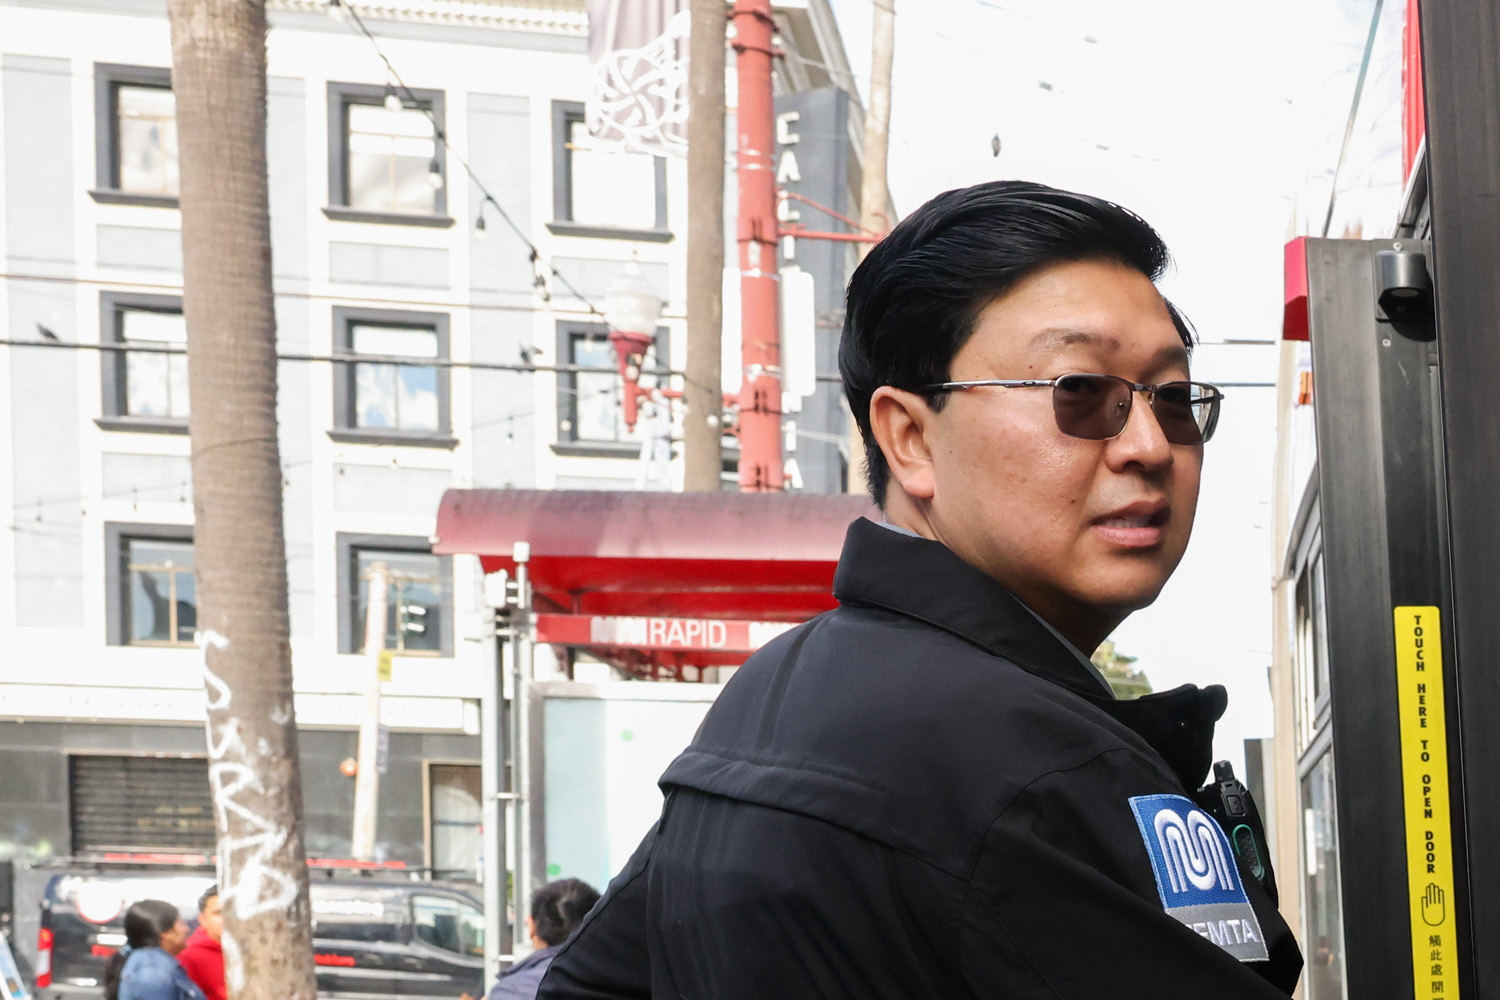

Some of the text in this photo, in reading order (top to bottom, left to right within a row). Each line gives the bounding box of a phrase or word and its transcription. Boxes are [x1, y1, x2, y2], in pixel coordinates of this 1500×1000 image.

[649, 618, 727, 648] RAPID
[1413, 615, 1436, 874] TOUCH HERE TO OPEN DOOR
[1185, 919, 1261, 946] FMTA
